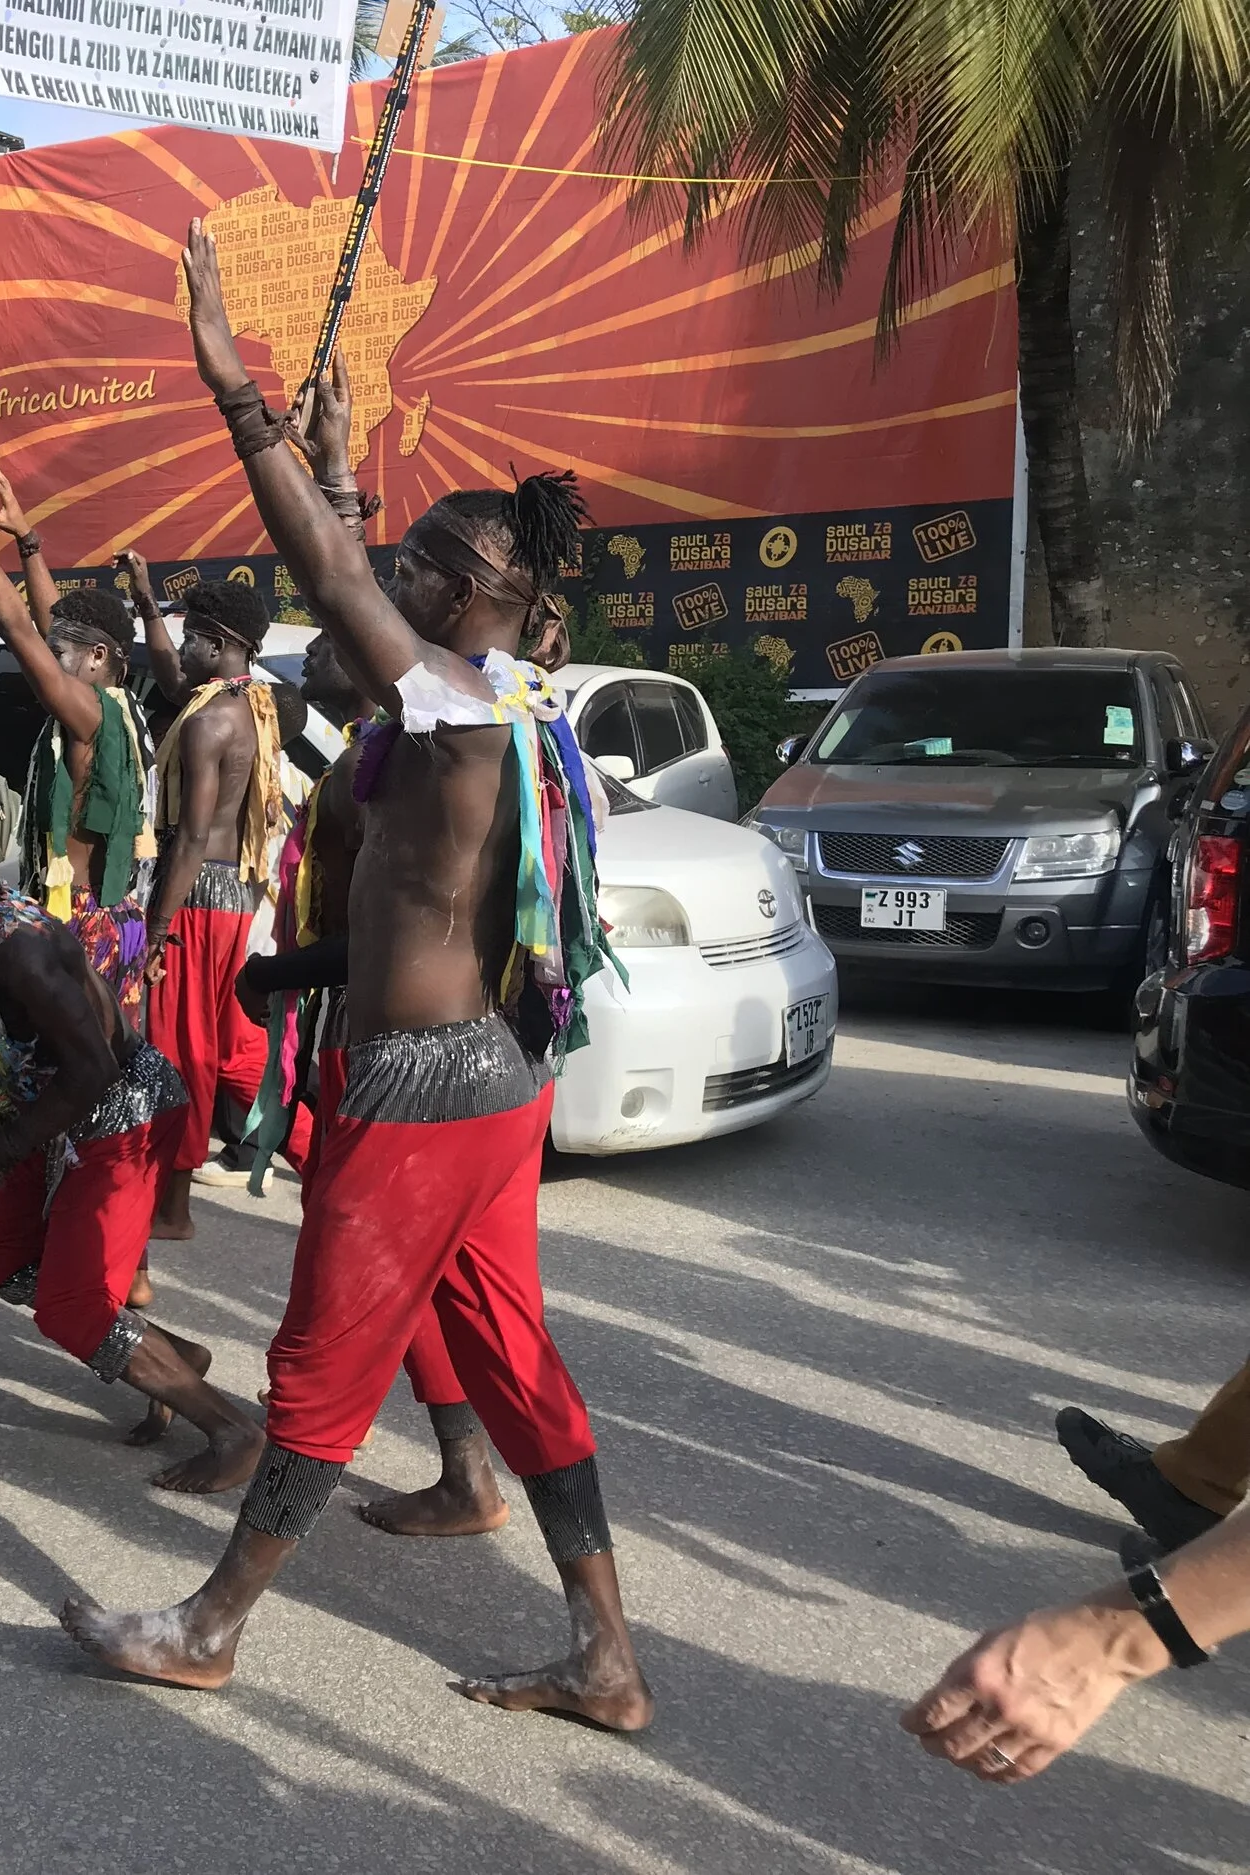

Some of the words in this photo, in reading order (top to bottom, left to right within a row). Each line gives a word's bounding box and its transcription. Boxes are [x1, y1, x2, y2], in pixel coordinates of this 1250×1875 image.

[90, 0, 161, 36] KUPITIA
[167, 8, 222, 45] POSTA
[228, 18, 248, 50] YA
[253, 23, 317, 62] ZAMANI
[319, 36, 342, 64] NA
[59, 34, 81, 67] LA
[126, 46, 148, 77] YA
[152, 50, 219, 87] ZAMANI
[223, 60, 302, 100] KUELEKEA
[0, 66, 30, 96] YA
[30, 73, 80, 104] ENEO
[81, 81, 106, 108] LA
[106, 85, 140, 114] MJI
[141, 89, 175, 119] WA
[238, 104, 267, 132] WA
[269, 108, 320, 140] DUNIA
[211, 219, 240, 234] sauti
[261, 210, 291, 226] sauti
[261, 218, 309, 238] busara
[236, 249, 266, 264] sauti
[286, 241, 317, 256] sauti
[236, 257, 284, 276] busara
[286, 248, 335, 268] busara
[261, 279, 291, 294] sauti
[261, 287, 309, 307] busara
[286, 310, 316, 327] sauti
[393, 294, 424, 309] sauti
[365, 334, 396, 346] sauti
[670, 534, 707, 547] sauti
[714, 532, 731, 545] za
[826, 524, 867, 538] sauti
[874, 522, 892, 535] za
[917, 517, 967, 545] 100%
[670, 544, 731, 562] busara
[825, 534, 892, 553] busara
[924, 531, 971, 560] LIVE
[670, 559, 731, 572] ZANZIBAR
[825, 550, 892, 563] ZANZIBAR
[165, 571, 198, 592] 100%
[746, 585, 783, 598] sauti
[789, 583, 808, 596] za
[908, 576, 951, 590] sauti
[958, 575, 978, 588] za
[599, 593, 633, 605] sauti
[638, 591, 654, 603] za
[676, 589, 718, 613] 100%
[745, 596, 808, 613] busara
[908, 587, 978, 605] busara
[607, 602, 654, 619] usara
[682, 600, 723, 628] LIVE
[745, 609, 808, 623] ZANZIBAR
[908, 602, 978, 616] ZANZIBAR
[830, 636, 876, 661] 100%
[836, 650, 878, 676] LIVE
[878, 890, 889, 907] Z
[894, 891, 931, 909] 993
[893, 910, 916, 927] JT
[795, 1006, 803, 1031] Z
